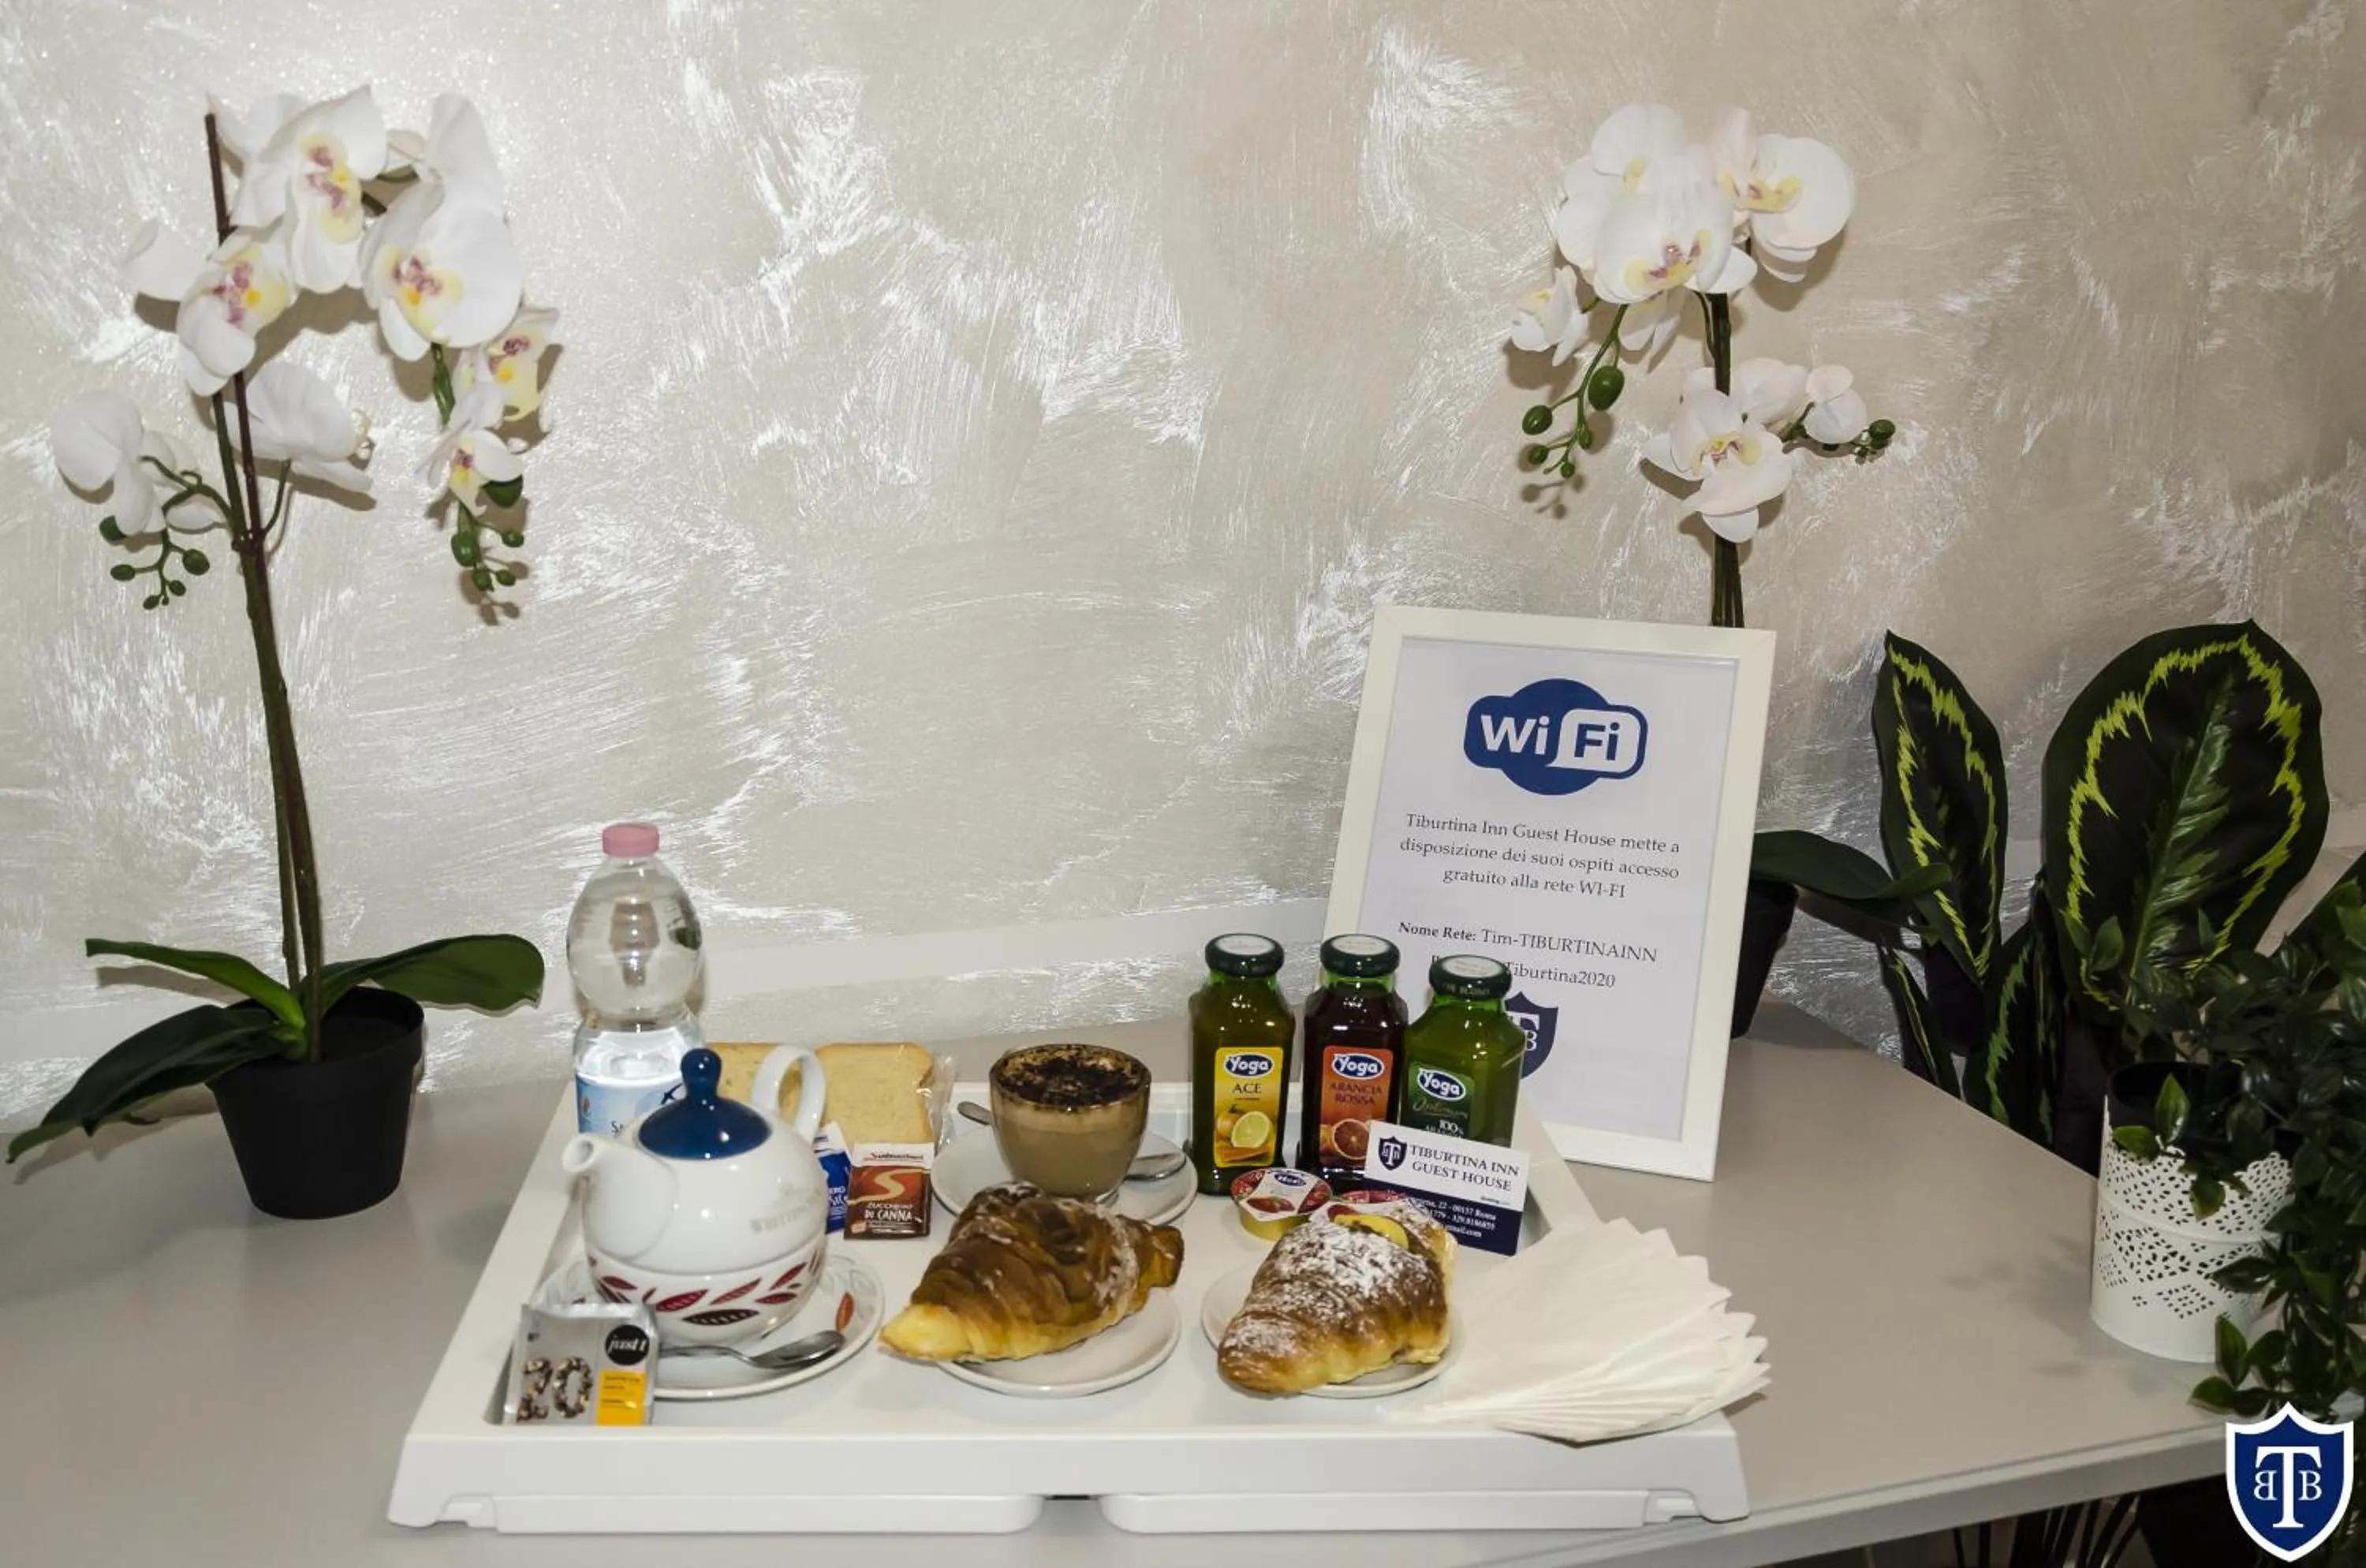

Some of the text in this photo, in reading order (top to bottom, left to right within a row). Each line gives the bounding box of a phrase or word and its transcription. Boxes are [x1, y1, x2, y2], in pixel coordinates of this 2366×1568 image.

[1480, 715, 1621, 761] Wi Fi
[1406, 813, 1680, 853] Tiburtina Inn Guest House mette a
[1400, 838, 1680, 879] disposizione dei suoi ospiti accesso
[1442, 869, 1626, 898] gratuito alla rete WI-FI
[1398, 922, 1658, 963] Nome Rete: Tim-TIBURTINAINN
[1506, 961, 1616, 987] Tiburtina2020
[1227, 1055, 1269, 1075] Yoga
[1336, 1055, 1379, 1077] Yoga
[1232, 1083, 1262, 1094] ACE
[1330, 1081, 1383, 1096] ARANCIA
[1420, 1070, 1460, 1096] Yoga
[1334, 1091, 1375, 1104] ROSSA
[1410, 1144, 1520, 1177] TIBURTINA INN
[1412, 1161, 1513, 1192] GUEST HOUSE
[877, 1209, 913, 1222] CANNA
